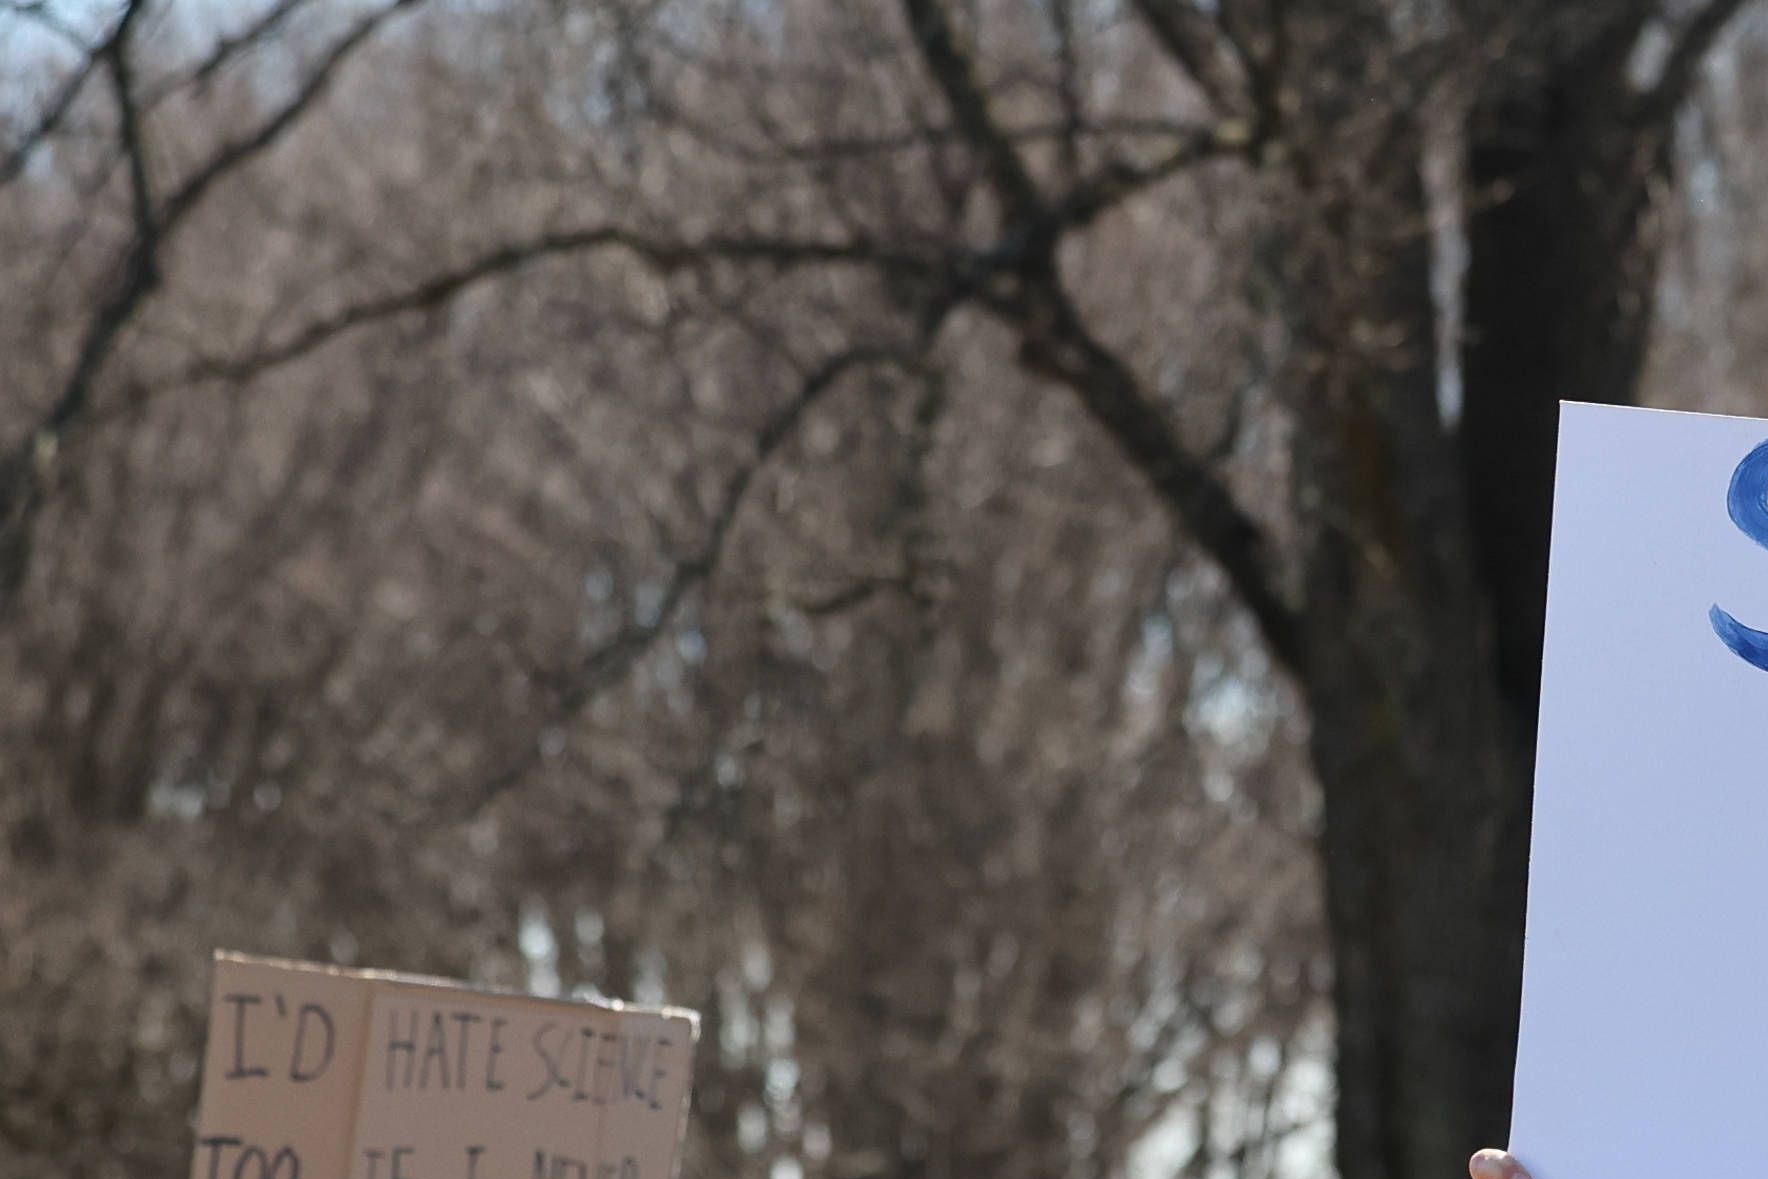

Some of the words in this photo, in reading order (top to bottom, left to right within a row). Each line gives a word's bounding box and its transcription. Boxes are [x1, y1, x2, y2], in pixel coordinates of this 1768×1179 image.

[223, 994, 336, 1082] I'D
[384, 1010, 509, 1092] HATE
[526, 1019, 674, 1111] SCIENCE
